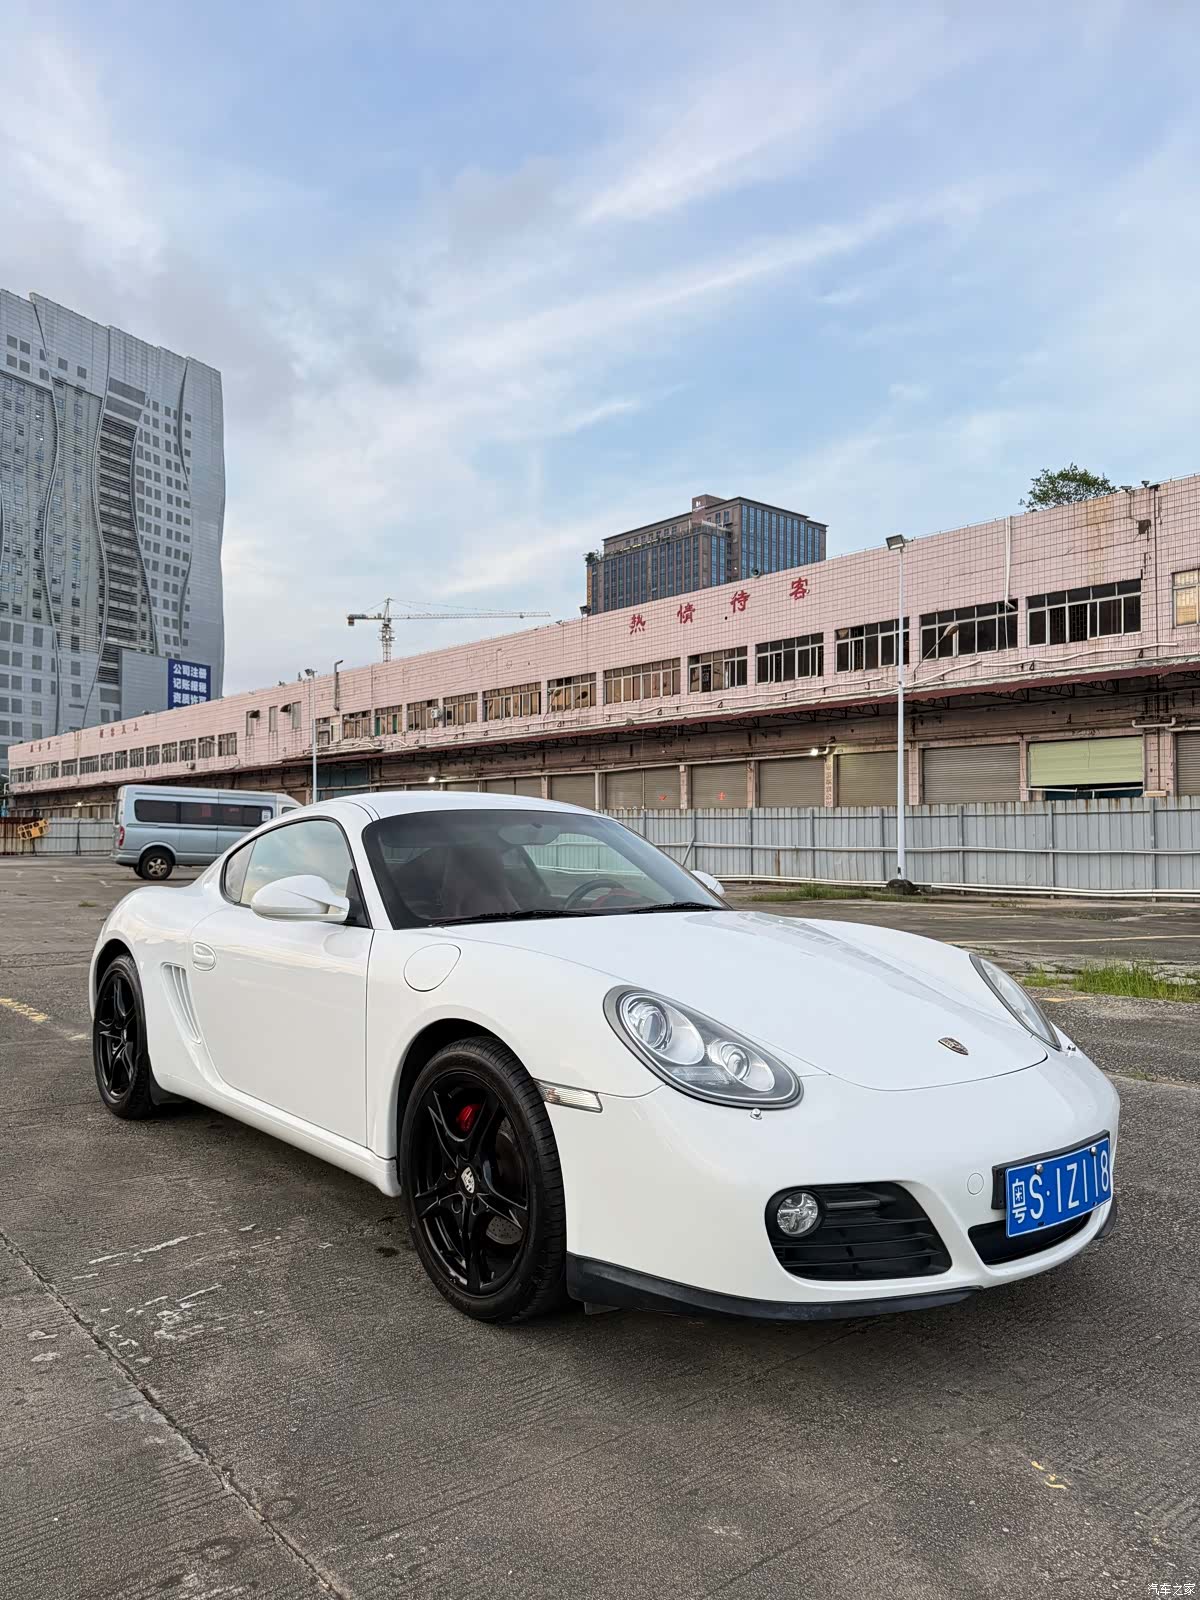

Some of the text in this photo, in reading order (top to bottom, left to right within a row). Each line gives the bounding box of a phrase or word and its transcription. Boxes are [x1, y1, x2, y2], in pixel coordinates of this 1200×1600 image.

[629, 577, 809, 634] 热情待客
[173, 663, 207, 679] 公司注册
[173, 677, 207, 693] 记账报税
